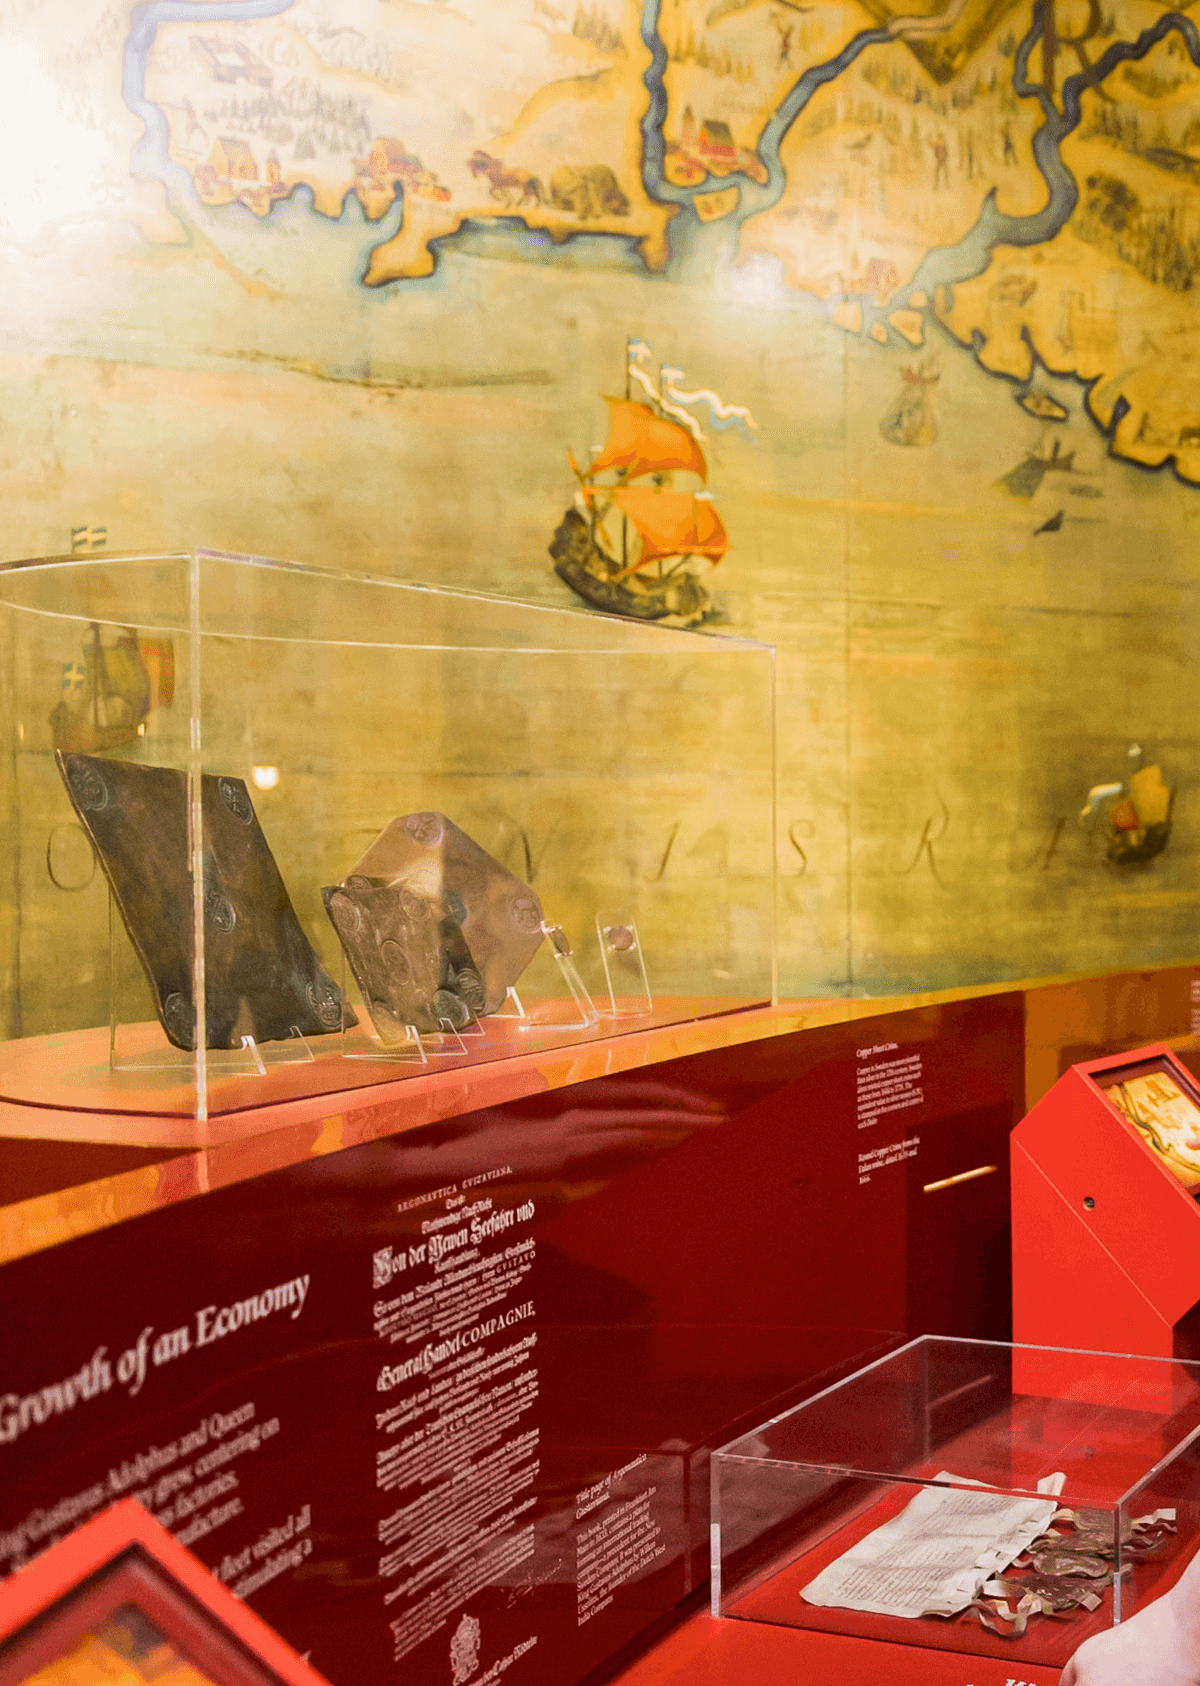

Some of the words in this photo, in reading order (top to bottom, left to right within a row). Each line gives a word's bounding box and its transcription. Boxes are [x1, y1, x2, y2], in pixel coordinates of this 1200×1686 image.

[408, 1243, 427, 1268] der
[0, 1346, 113, 1444] Growth
[116, 1325, 154, 1397] of
[152, 1325, 192, 1367] an
[194, 1273, 310, 1349] Economy
